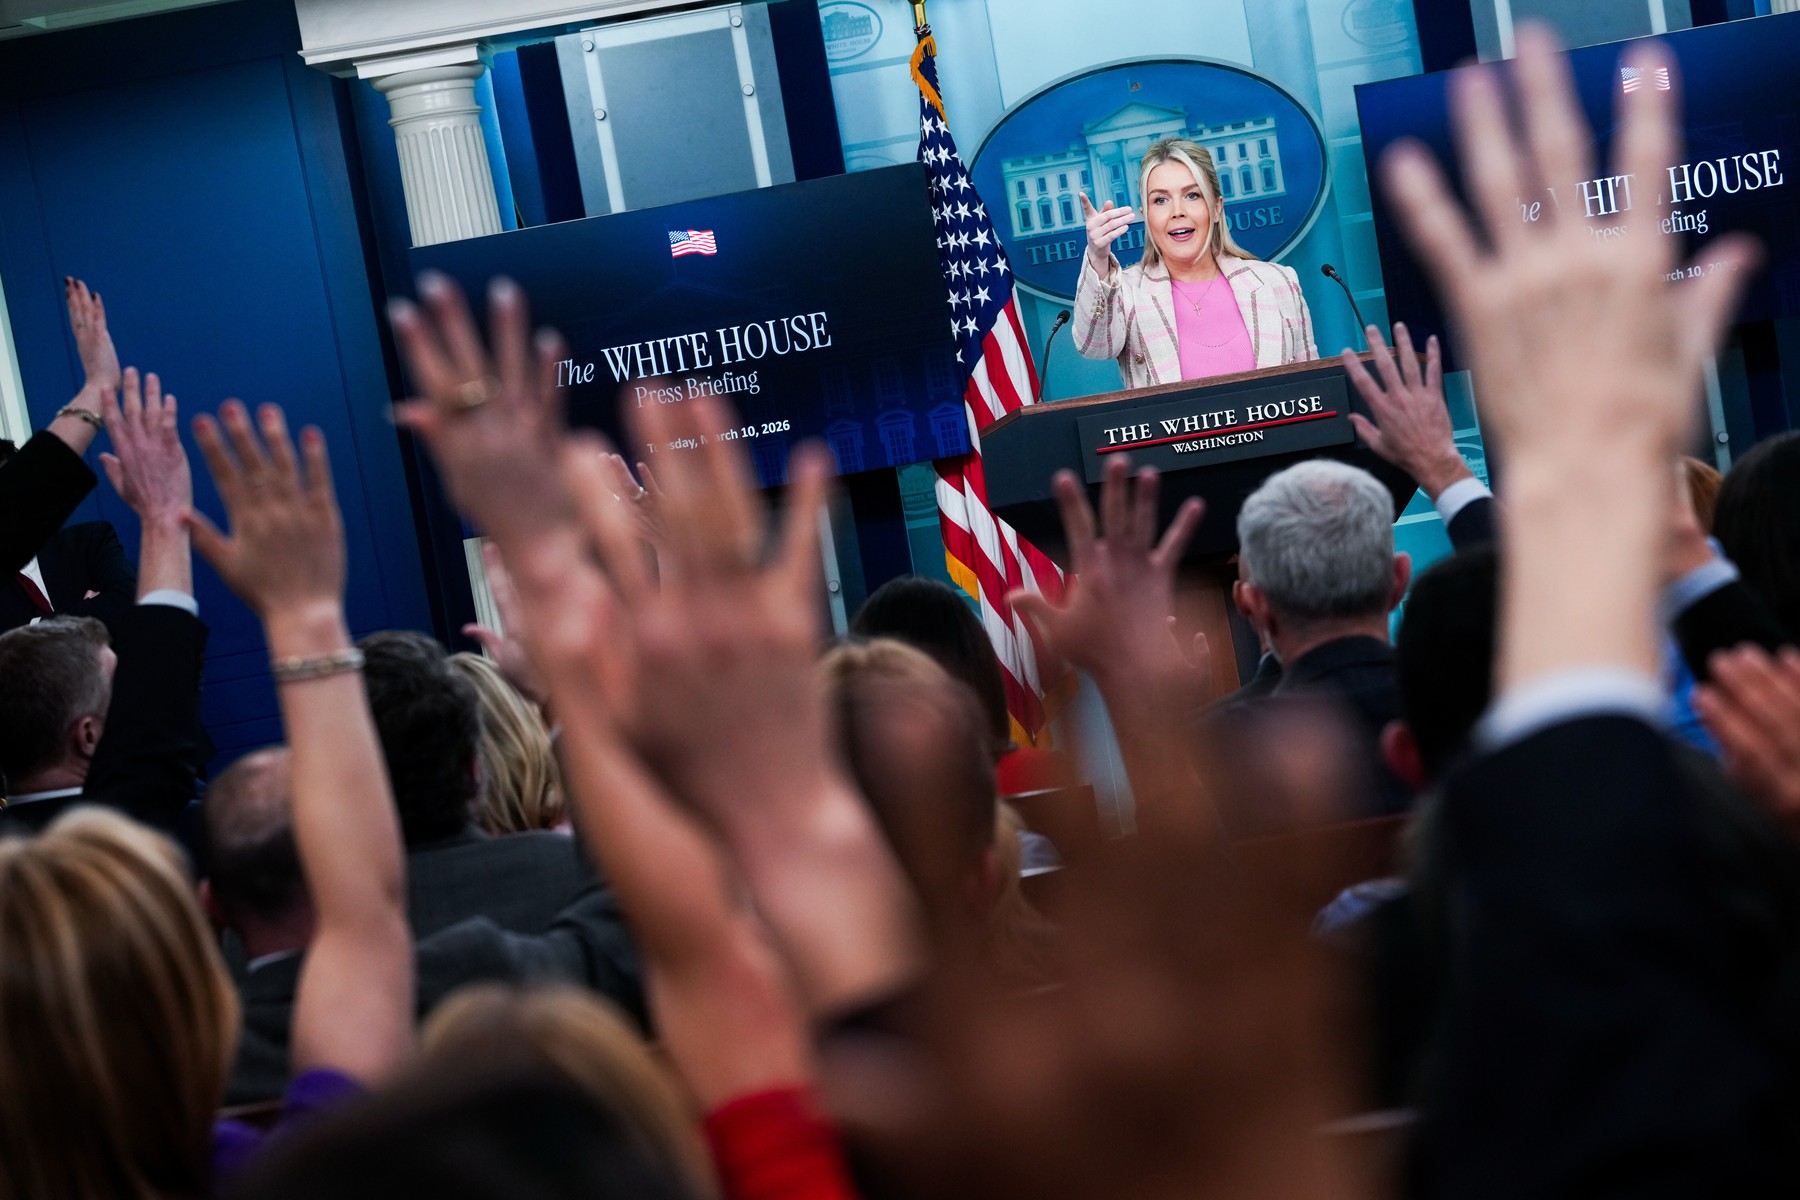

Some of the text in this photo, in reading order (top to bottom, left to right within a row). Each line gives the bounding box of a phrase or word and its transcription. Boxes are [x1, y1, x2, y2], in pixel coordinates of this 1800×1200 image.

[1547, 174, 1662, 218] HIT
[1666, 149, 1784, 204] HOUSE
[1026, 206, 1284, 266] THE USE
[1656, 210, 1709, 234] iefing
[553, 311, 832, 388] The WHITE HOUSE
[634, 370, 760, 408] Press Briefing
[647, 437, 698, 454] Tsday,
[741, 426, 759, 438] 10,
[761, 420, 791, 435] 2026
[1104, 395, 1324, 445] THE WHITE HOUSE
[1172, 430, 1264, 454] WASHINGTON
